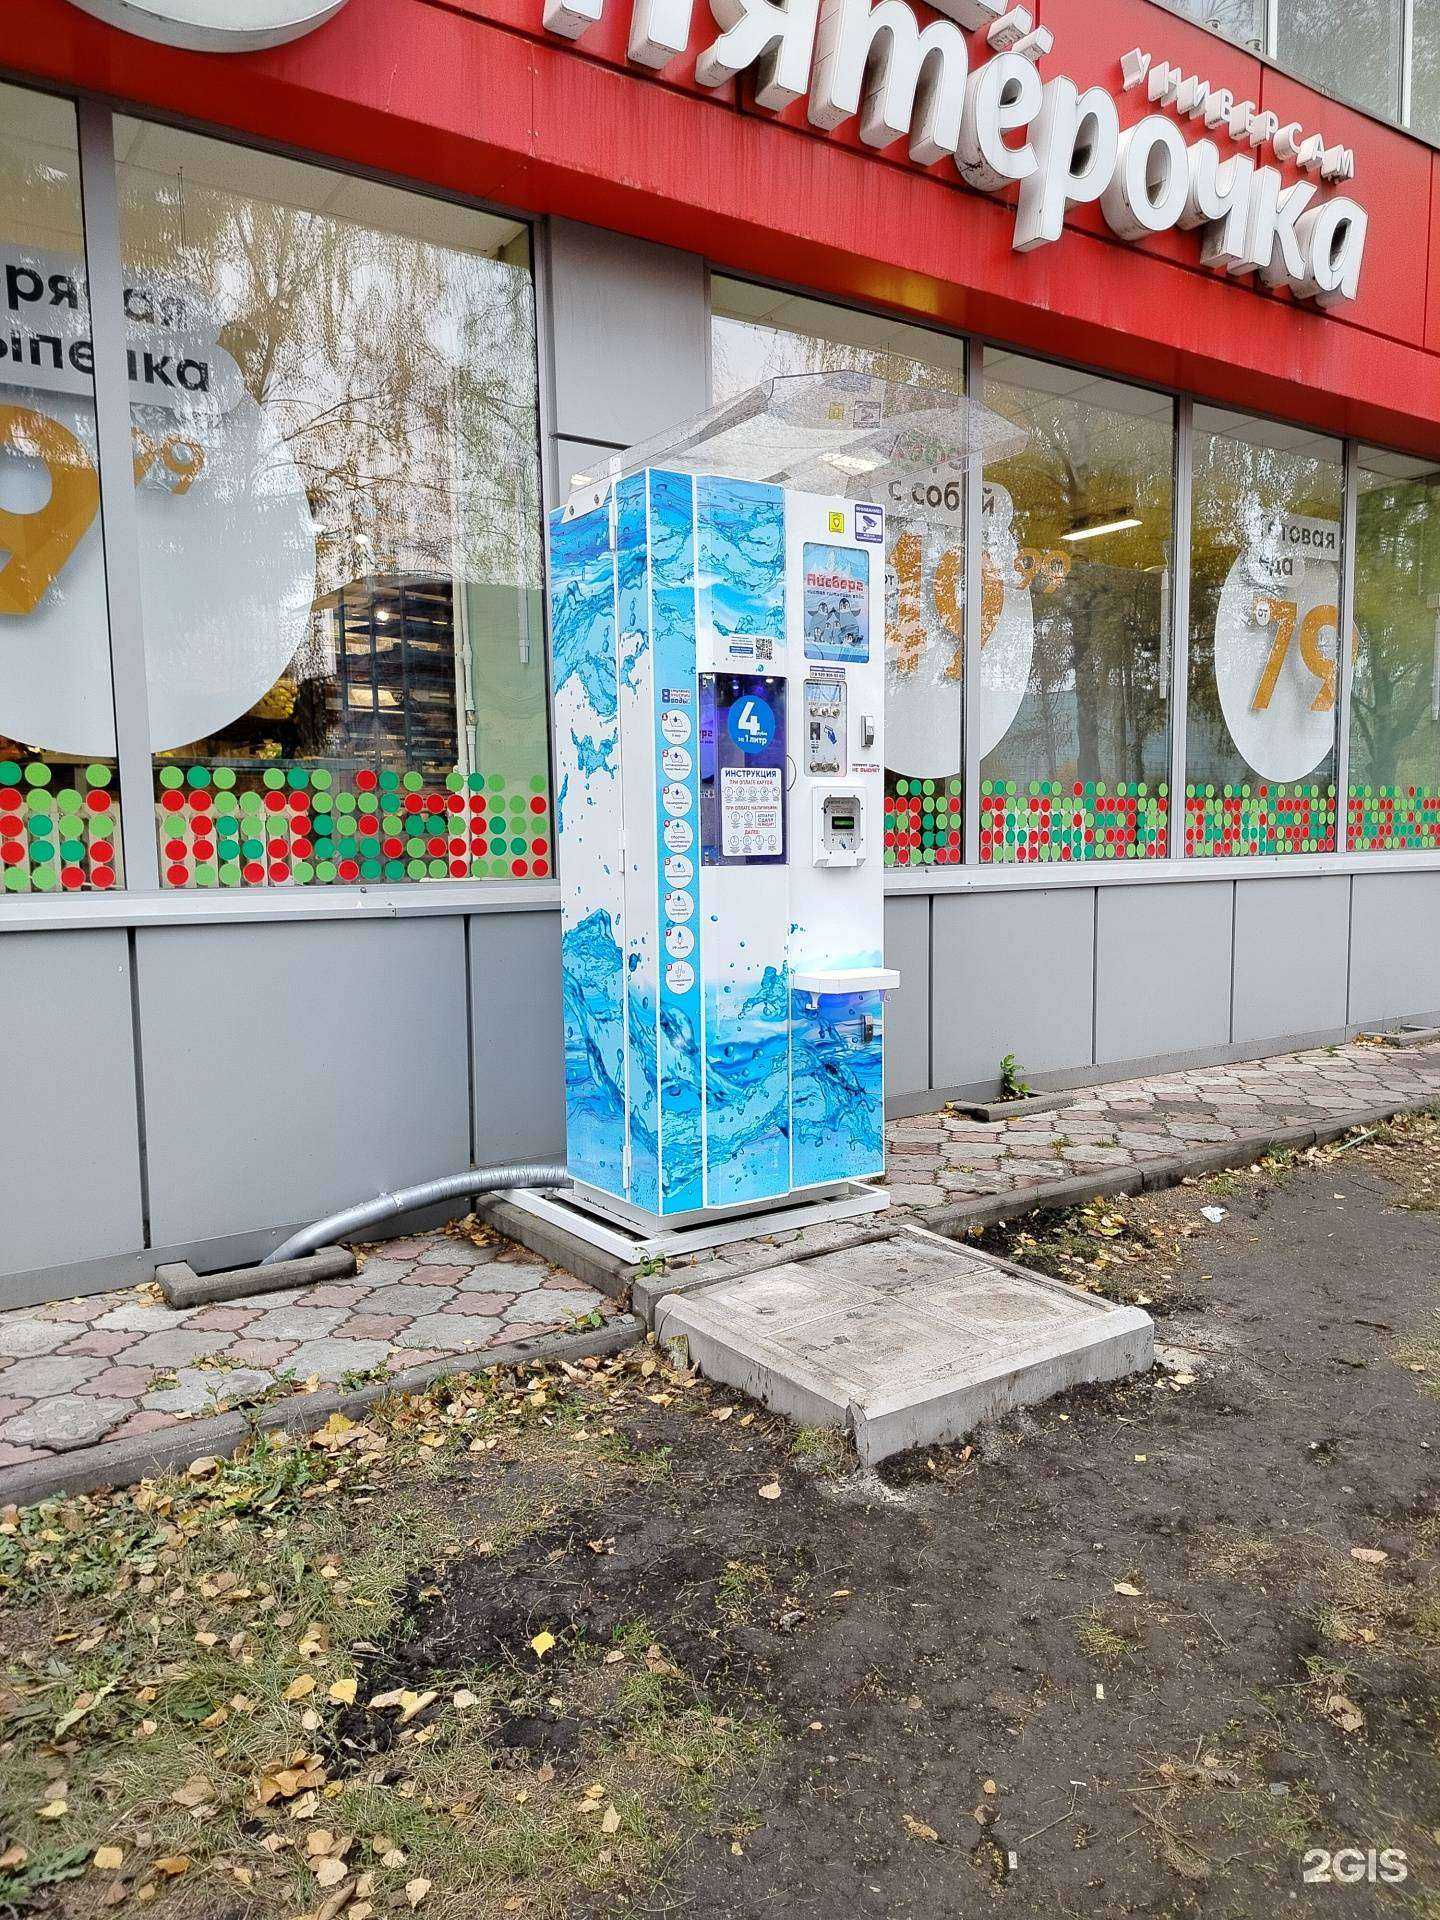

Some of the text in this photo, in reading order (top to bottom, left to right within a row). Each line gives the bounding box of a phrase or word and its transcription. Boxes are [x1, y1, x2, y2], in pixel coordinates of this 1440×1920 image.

[1120, 47, 1354, 184] УНИВЕРСАМ
[807, 573, 864, 592] Айсберг
[1252, 597, 1358, 712] 79
[738, 701, 761, 736] 4
[745, 734, 749, 743] 1
[749, 736, 767, 746] литр
[725, 769, 777, 778] ИНСТРУКЦИЯ
